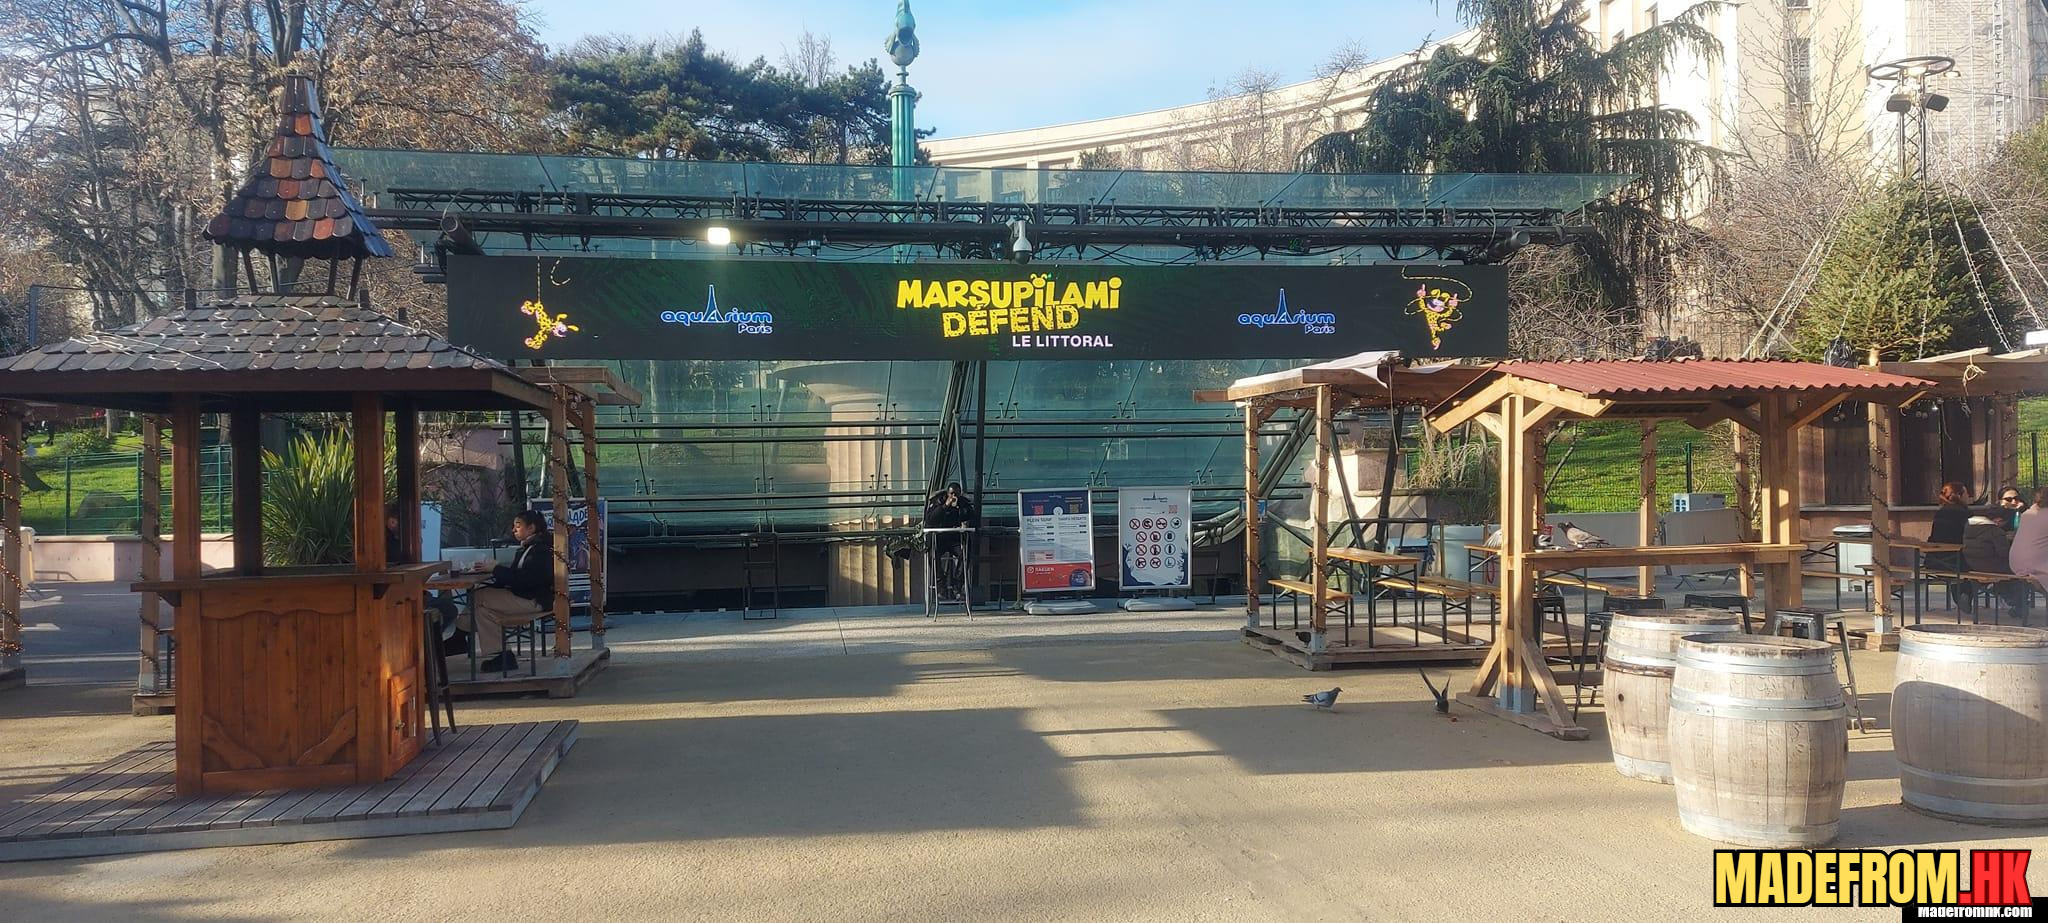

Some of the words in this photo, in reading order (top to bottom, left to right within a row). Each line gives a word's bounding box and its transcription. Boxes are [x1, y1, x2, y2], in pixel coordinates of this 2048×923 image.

[942, 303, 1079, 338] DÉFEND
[738, 323, 773, 334] Paris
[1304, 324, 1336, 334] Paris
[1012, 335, 1032, 347] LE
[1036, 335, 1113, 347] LITTORAL
